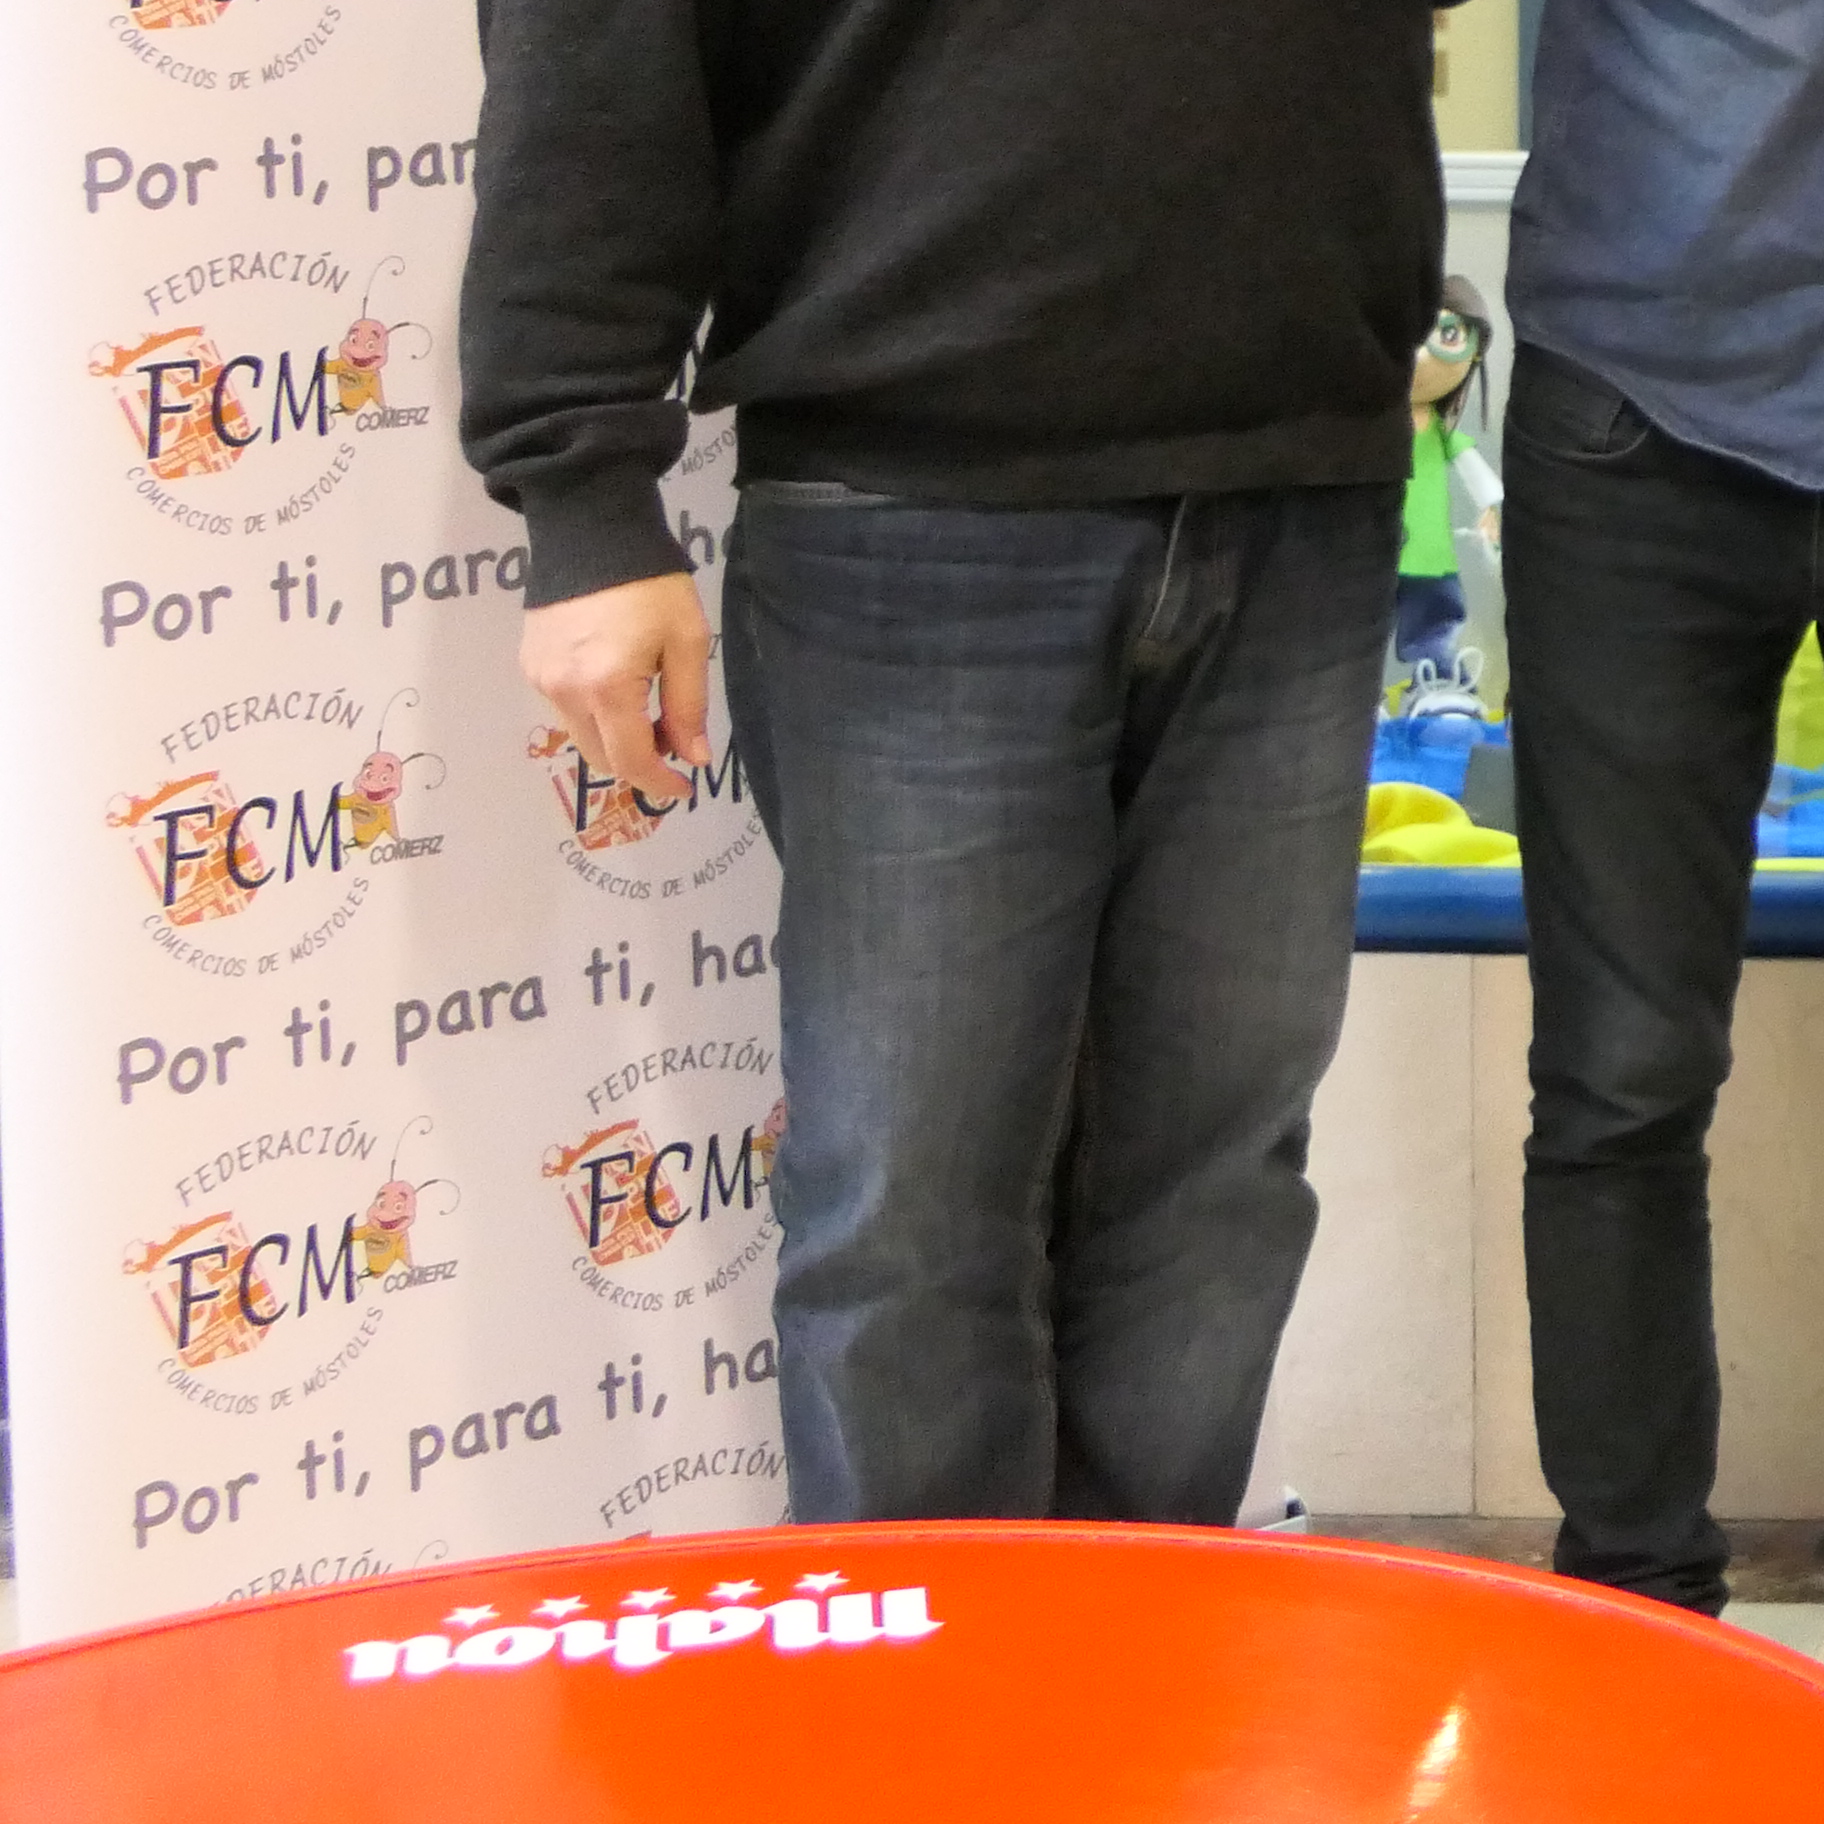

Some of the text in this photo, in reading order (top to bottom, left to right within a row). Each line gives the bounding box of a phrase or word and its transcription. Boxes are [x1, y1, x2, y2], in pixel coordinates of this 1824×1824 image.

[109, 6, 341, 90] COMERCIOS DE MÓSTOLES
[83, 134, 478, 213] Por ti, par
[144, 251, 349, 315] FEDERACIÓN
[137, 347, 327, 459] FCM
[100, 581, 232, 647] Por
[270, 555, 342, 625] ti,
[160, 688, 363, 763] FEDERACIÓN
[153, 783, 342, 907] FCM
[117, 1036, 246, 1104] Por
[283, 1000, 355, 1067] ti,
[395, 976, 547, 1066] para
[584, 942, 654, 1006] ti,
[175, 1120, 379, 1207] FEDERACIÓN
[580, 1126, 753, 1248] FCM
[168, 1214, 355, 1349] FCM
[133, 1473, 258, 1549] Por
[297, 1431, 369, 1500] ti,
[409, 1395, 561, 1492] para
[597, 1354, 666, 1420] ti,
[346, 1585, 945, 1682] mahou
